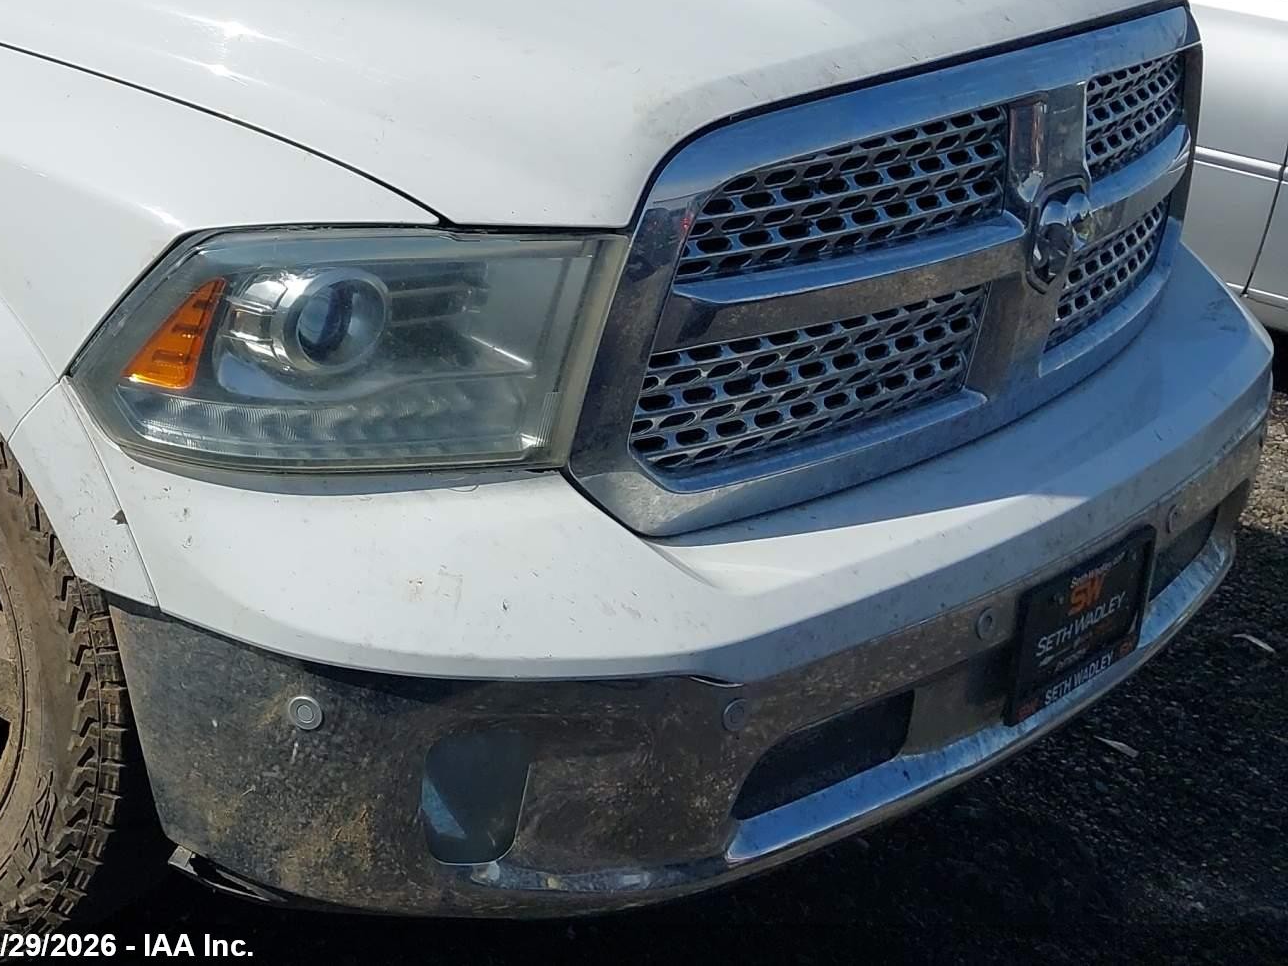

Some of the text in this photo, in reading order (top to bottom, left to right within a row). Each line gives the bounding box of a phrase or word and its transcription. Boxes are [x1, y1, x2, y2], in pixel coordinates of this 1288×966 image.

[1035, 624, 1073, 657] SETH
[1074, 591, 1126, 635] WADLEY
[1044, 679, 1072, 706] SETH
[1073, 650, 1114, 686] WADLEY
